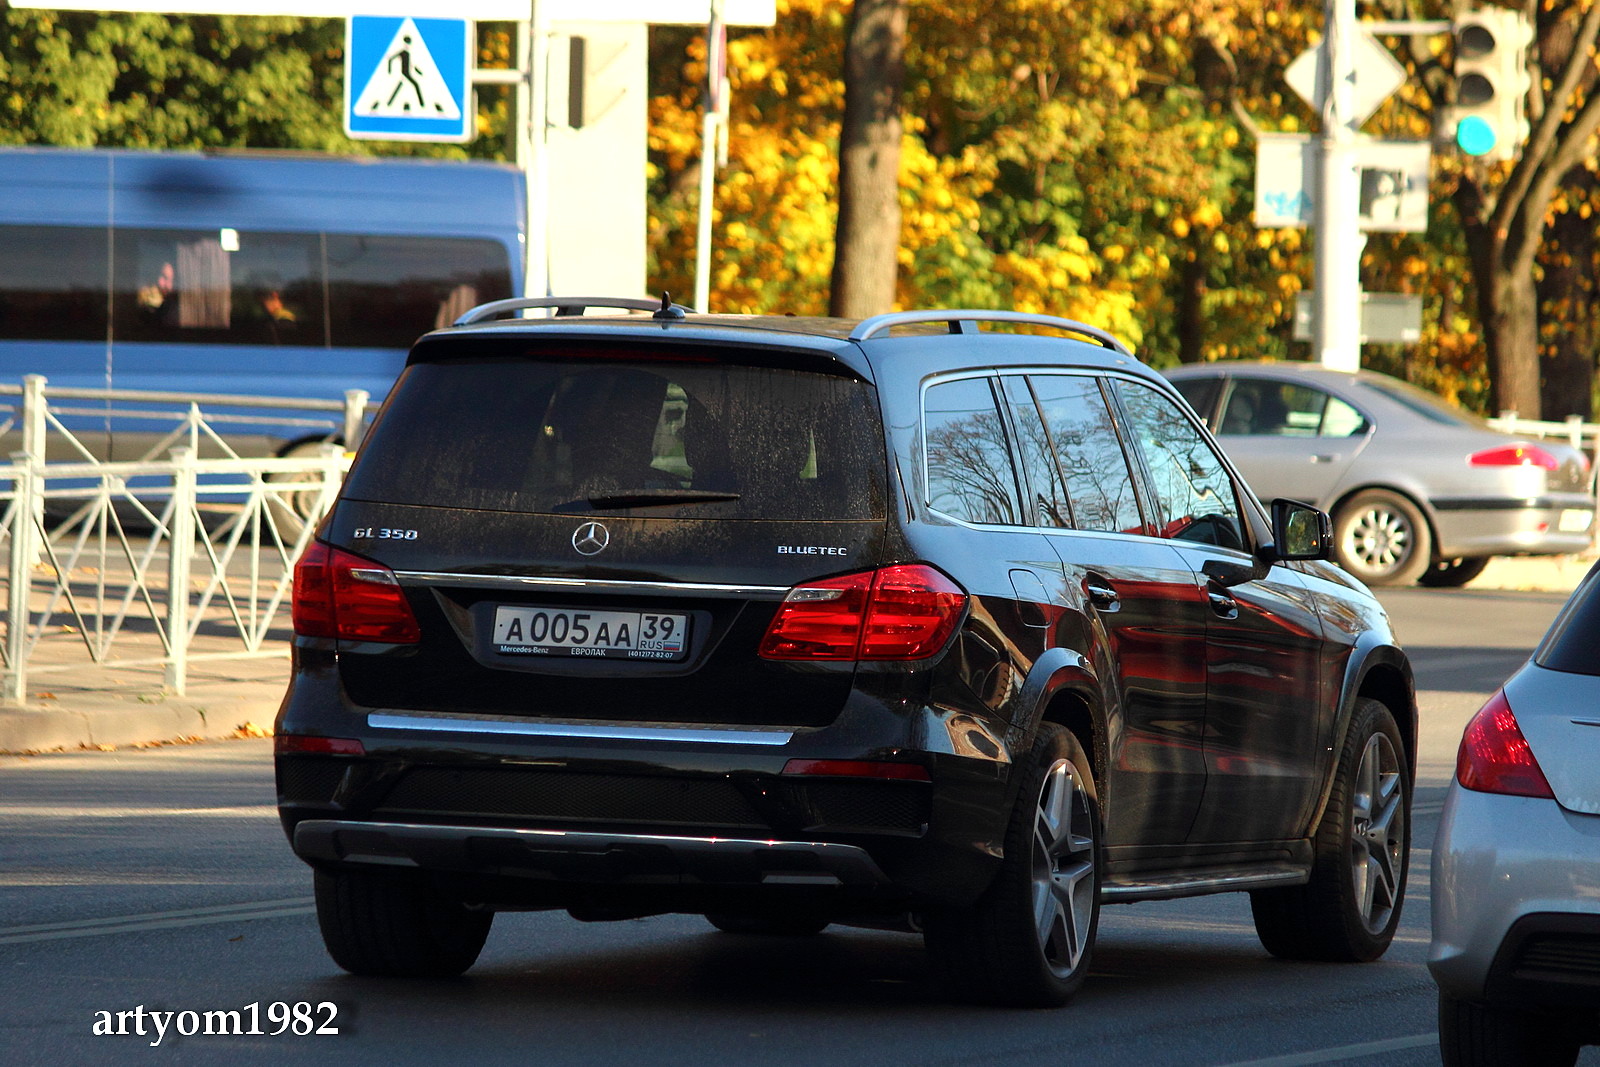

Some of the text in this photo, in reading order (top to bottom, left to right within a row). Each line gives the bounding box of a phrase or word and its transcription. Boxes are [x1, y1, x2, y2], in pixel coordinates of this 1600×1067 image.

[353, 527, 418, 540] GL 350
[777, 545, 847, 556] BLUETEC
[643, 616, 675, 641] 39
[500, 645, 549, 654] Mercedes-Benz
[640, 640, 663, 650] RUS
